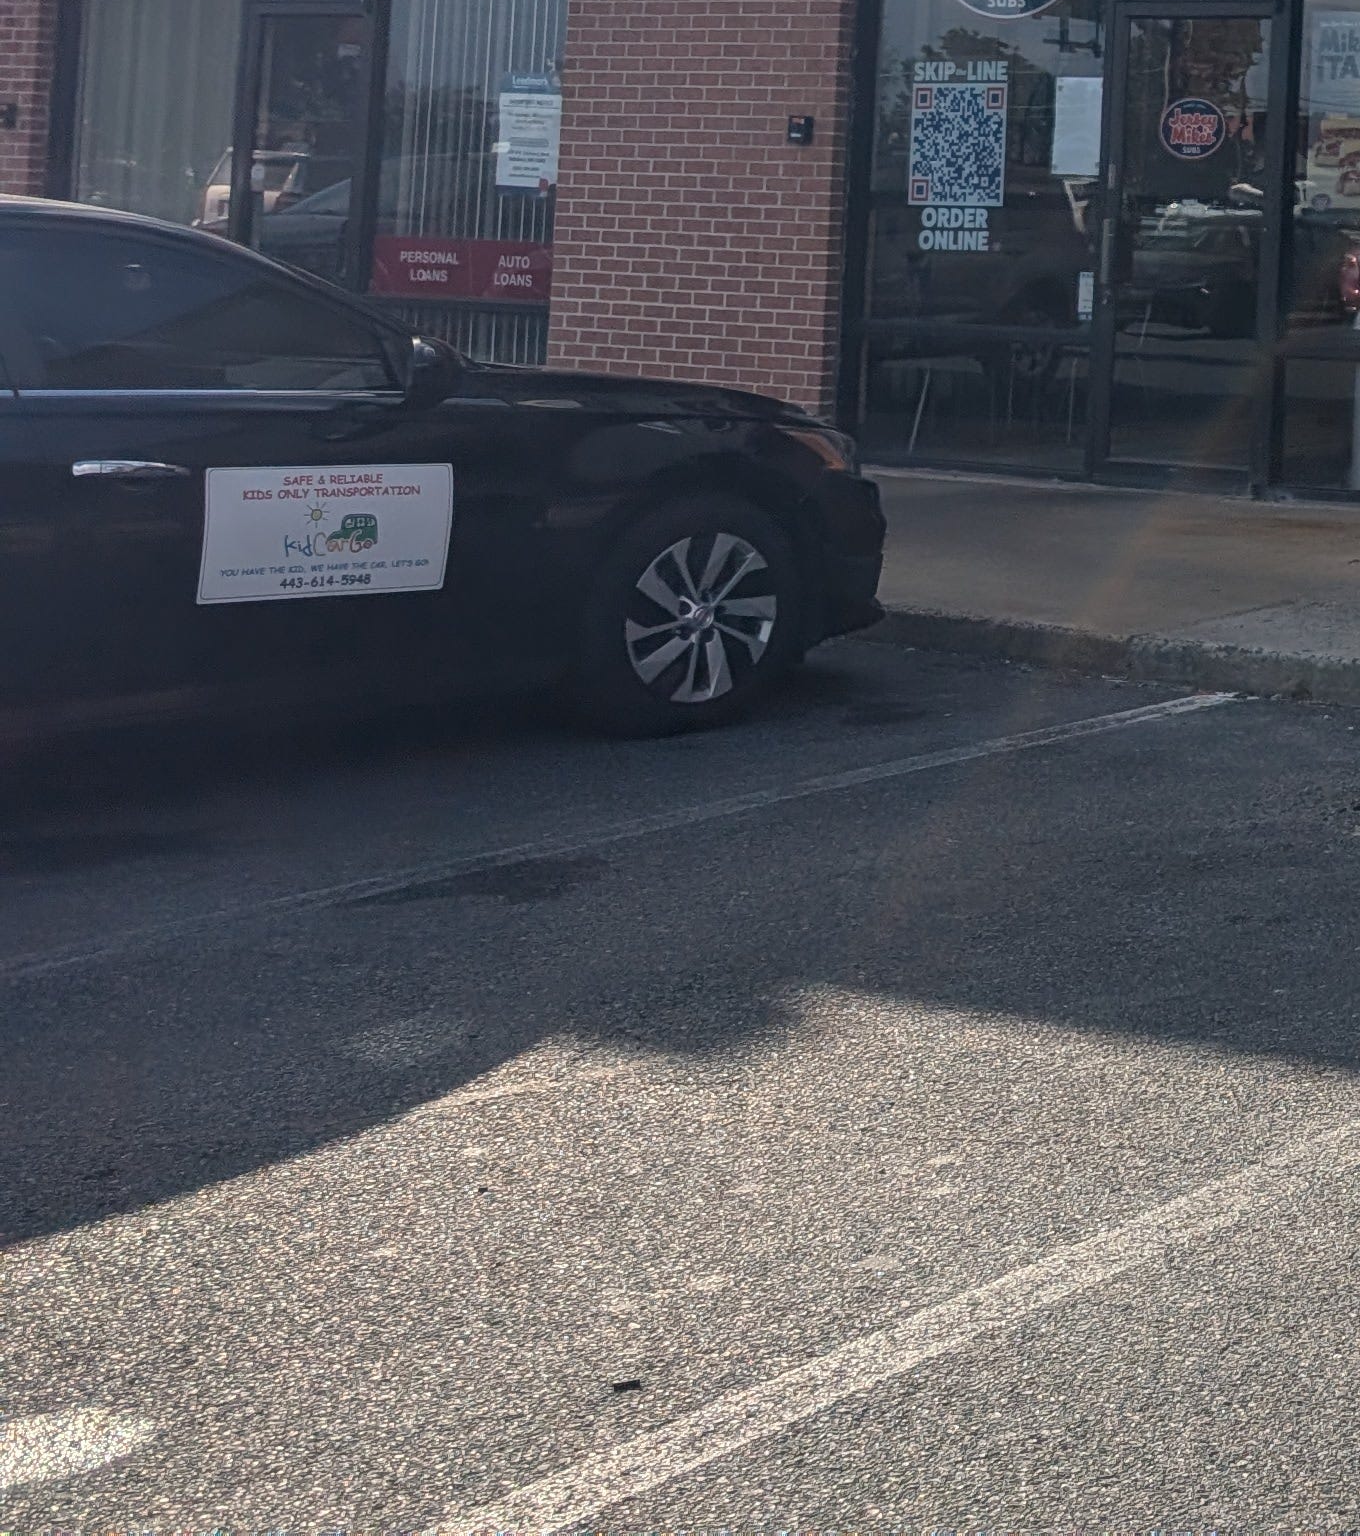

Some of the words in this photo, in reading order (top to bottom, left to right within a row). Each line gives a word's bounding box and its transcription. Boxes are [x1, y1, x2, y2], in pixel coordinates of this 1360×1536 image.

[914, 61, 956, 82] SKIP
[967, 61, 1008, 81] LINE
[1168, 107, 1218, 133] Jersey
[921, 207, 988, 228] ORDER
[918, 230, 990, 252] ONLINE
[400, 250, 459, 265] PERSONAL
[498, 255, 530, 269] AUTO
[409, 268, 448, 282] LOANS
[494, 273, 533, 287] LOANS
[283, 475, 313, 486] SAFE
[318, 475, 326, 485] &
[330, 473, 384, 485] RELIABLE
[242, 489, 273, 500] KIDS
[278, 488, 310, 500] ONLY
[314, 485, 421, 498] TRANSPORTATION
[220, 569, 239, 577] YOU
[242, 568, 265, 576] HAVE
[269, 566, 286, 574] THE
[280, 573, 372, 589] 443-614-5948
